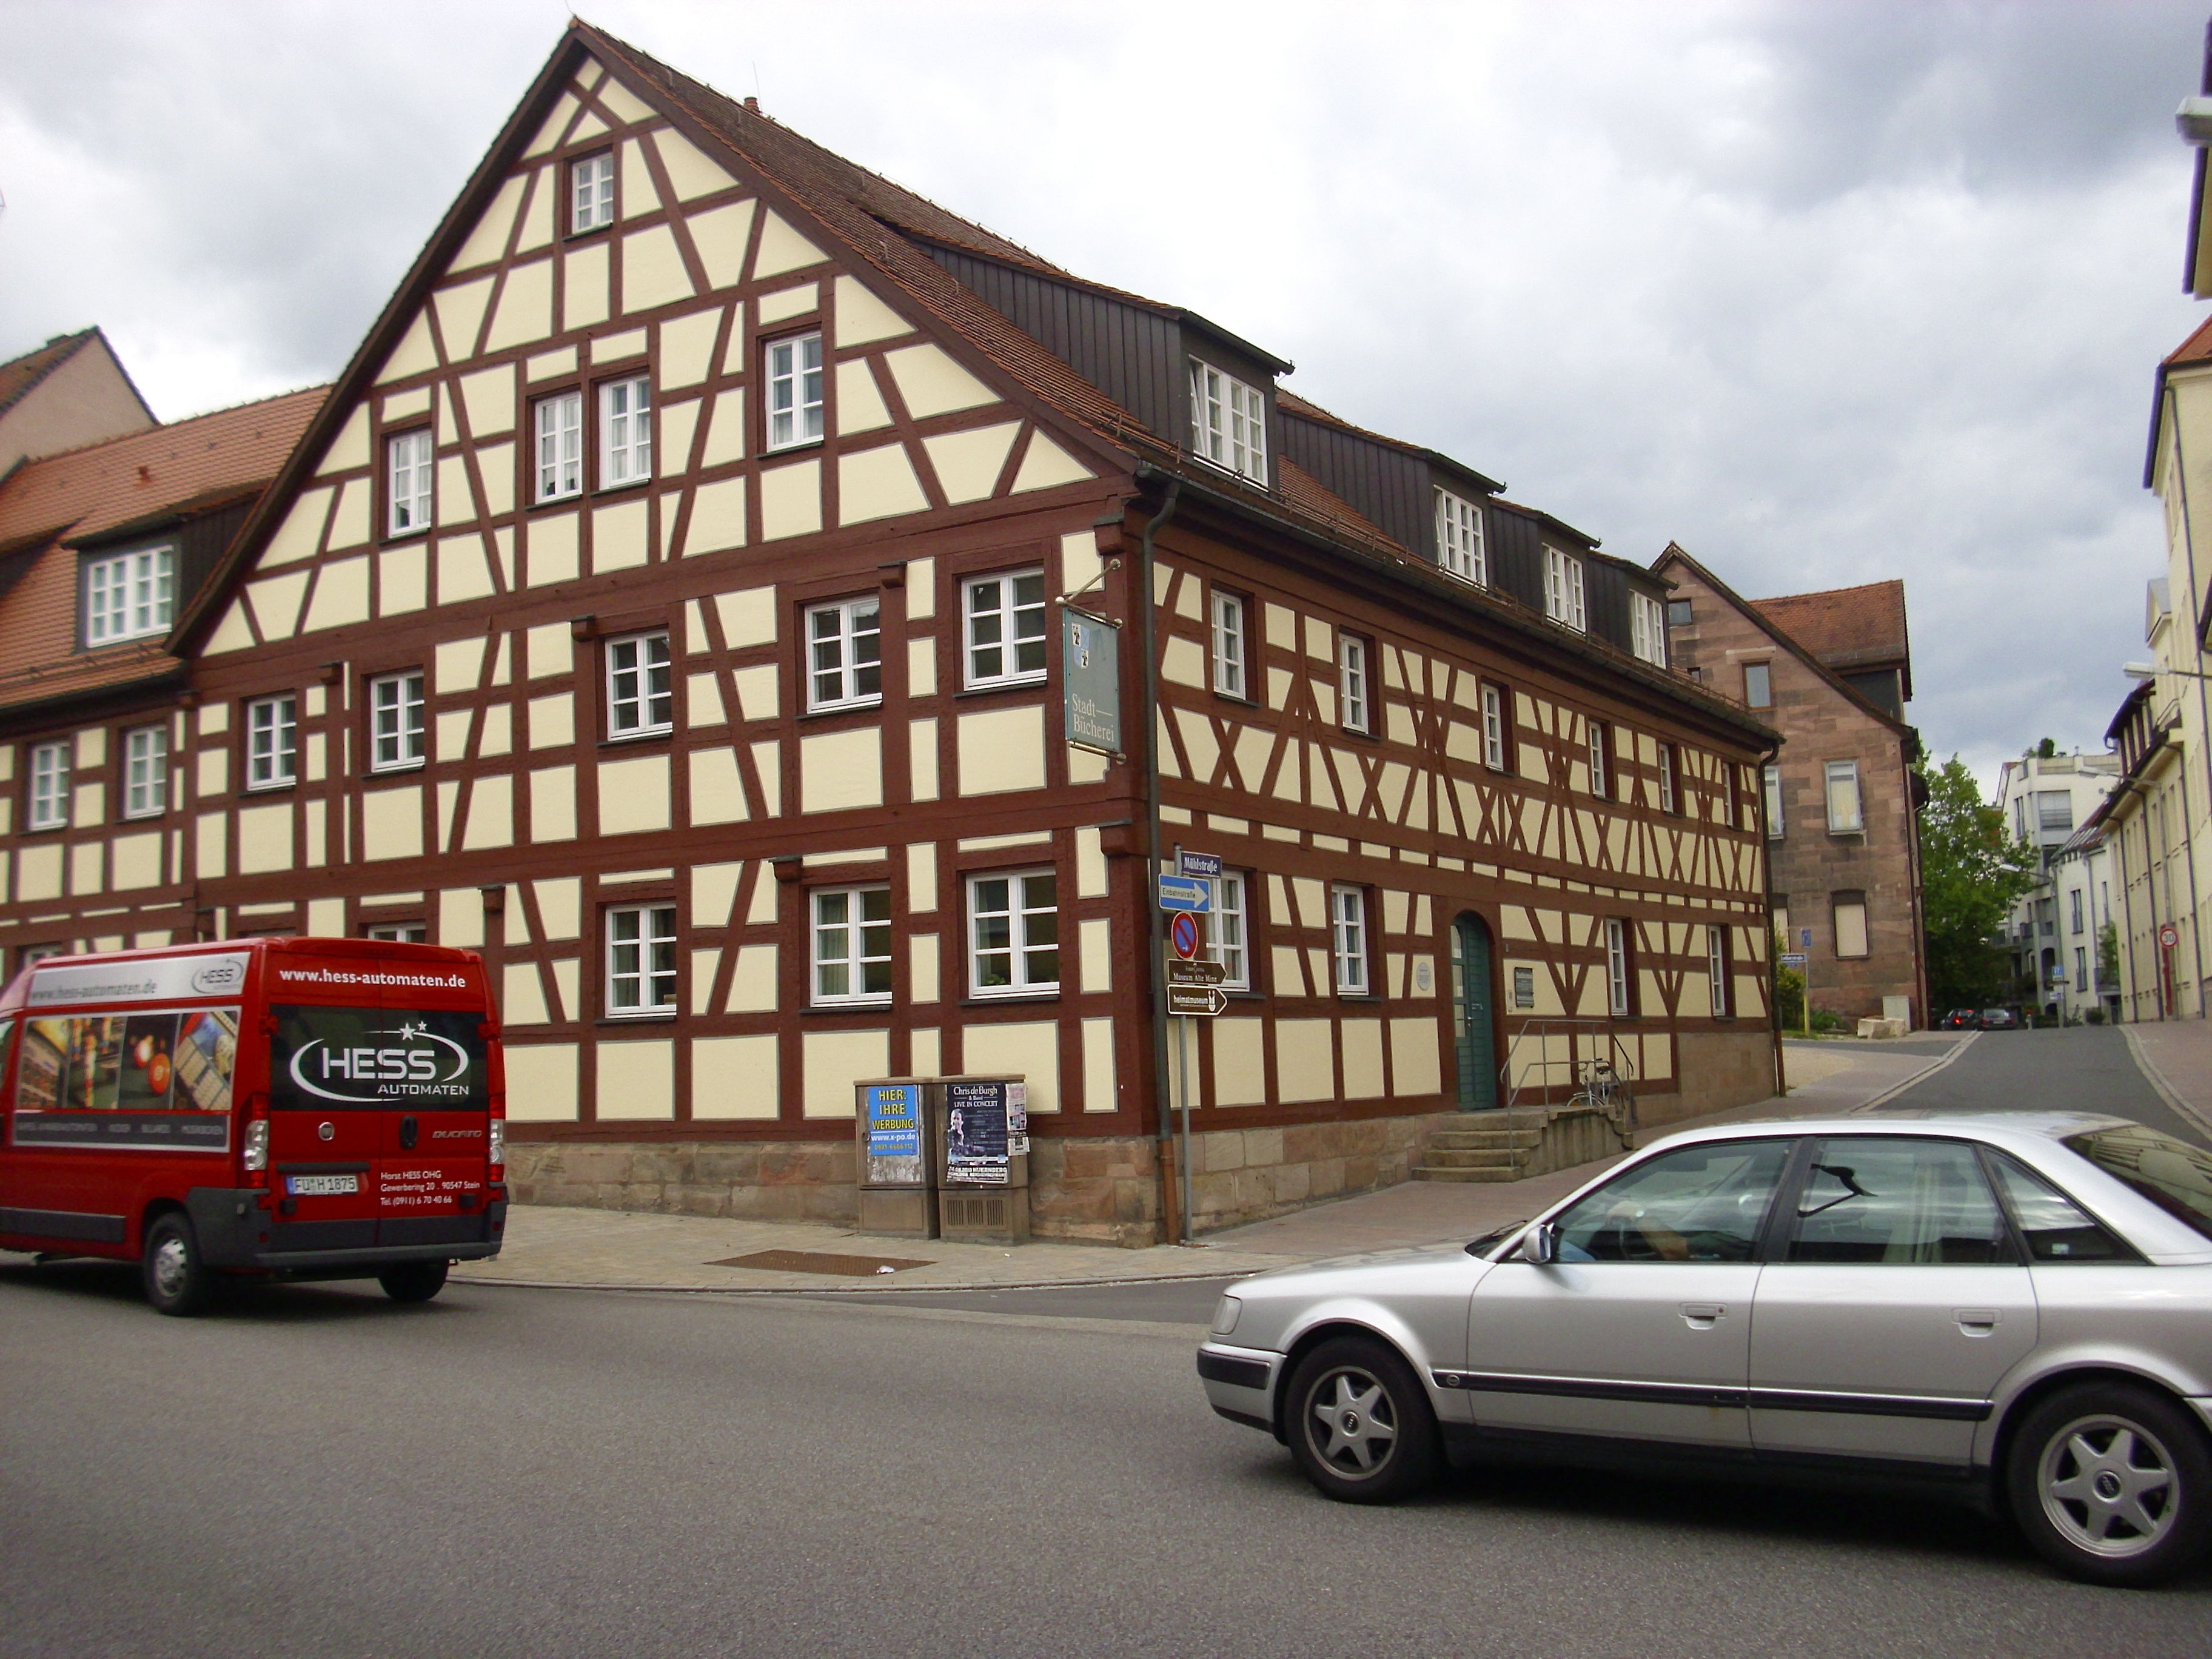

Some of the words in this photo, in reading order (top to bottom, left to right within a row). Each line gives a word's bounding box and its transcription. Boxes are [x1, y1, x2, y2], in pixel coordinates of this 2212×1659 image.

[1073, 714, 1114, 742] Bücherei
[1184, 857, 1218, 874] Mühlstraße
[1162, 887, 1195, 899] Einbahnstraße
[2163, 933, 2174, 943] 30
[199, 968, 233, 985] HESS
[280, 968, 466, 988] www.hess-automaten.de
[1173, 973, 1193, 981] Museum
[32, 978, 157, 1000] www.hess-automaten.de
[322, 1047, 437, 1080] HESS
[377, 1084, 470, 1096] AUTOMATEN
[879, 1089, 907, 1101] HIER:
[953, 1087, 970, 1095] Chris
[970, 1086, 979, 1094] de
[979, 1085, 998, 1096] Burgh
[879, 1103, 906, 1116] IHRE
[872, 1119, 914, 1130] WERBUNG
[871, 1132, 916, 1142] www.x-po.de
[403, 1171, 421, 1179] HESS
[422, 1170, 441, 1179] OHG
[327, 1178, 355, 1190] 1875
[380, 1184, 424, 1193] Gewerbering
[441, 1181, 462, 1190] 90547
[393, 1196, 415, 1207] (0911)
